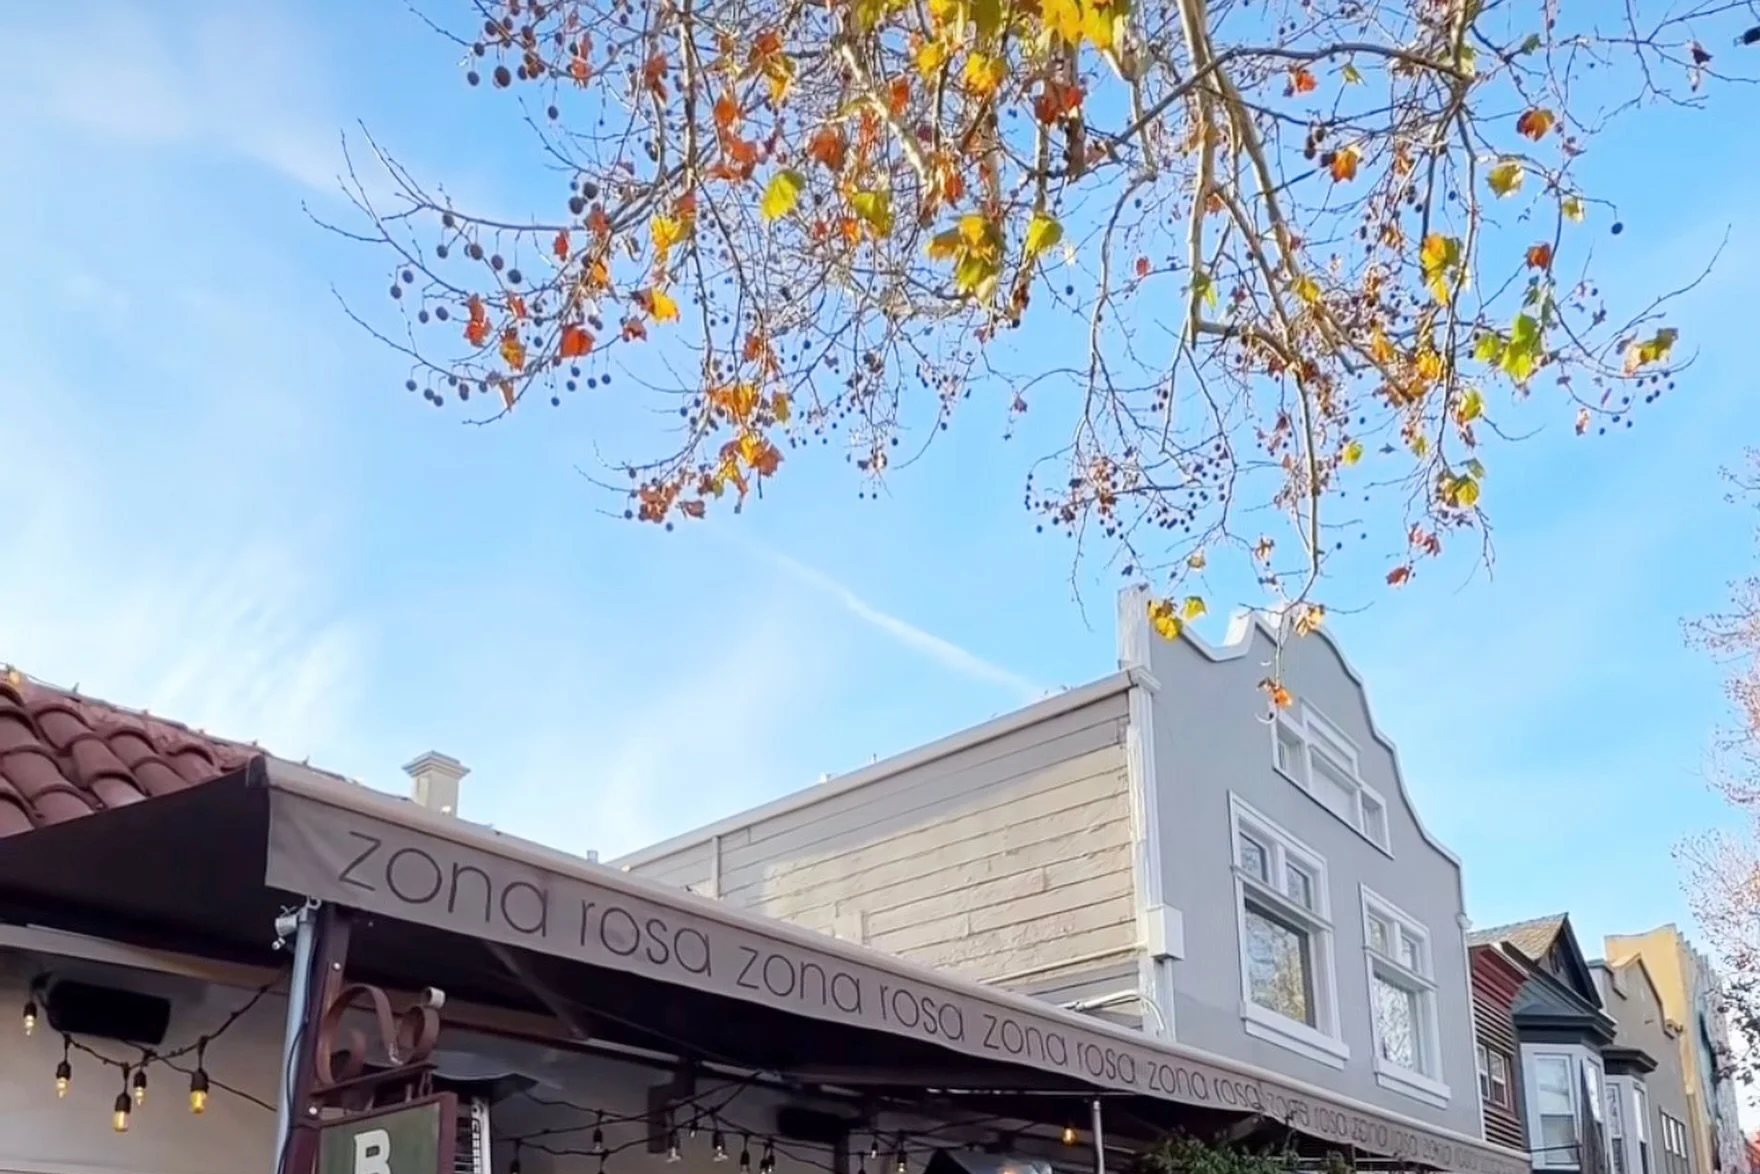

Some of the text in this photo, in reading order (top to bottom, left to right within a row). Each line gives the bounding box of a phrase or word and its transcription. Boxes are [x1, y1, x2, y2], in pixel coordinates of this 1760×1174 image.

[338, 830, 550, 938] zona
[580, 898, 712, 978] rosa
[735, 944, 863, 1015] zona
[879, 983, 966, 1042] rosa
[982, 1012, 1069, 1067] zona
[1076, 1040, 1136, 1085] rosa
[1147, 1059, 1208, 1101] zona
[1213, 1078, 1263, 1111] rosa
